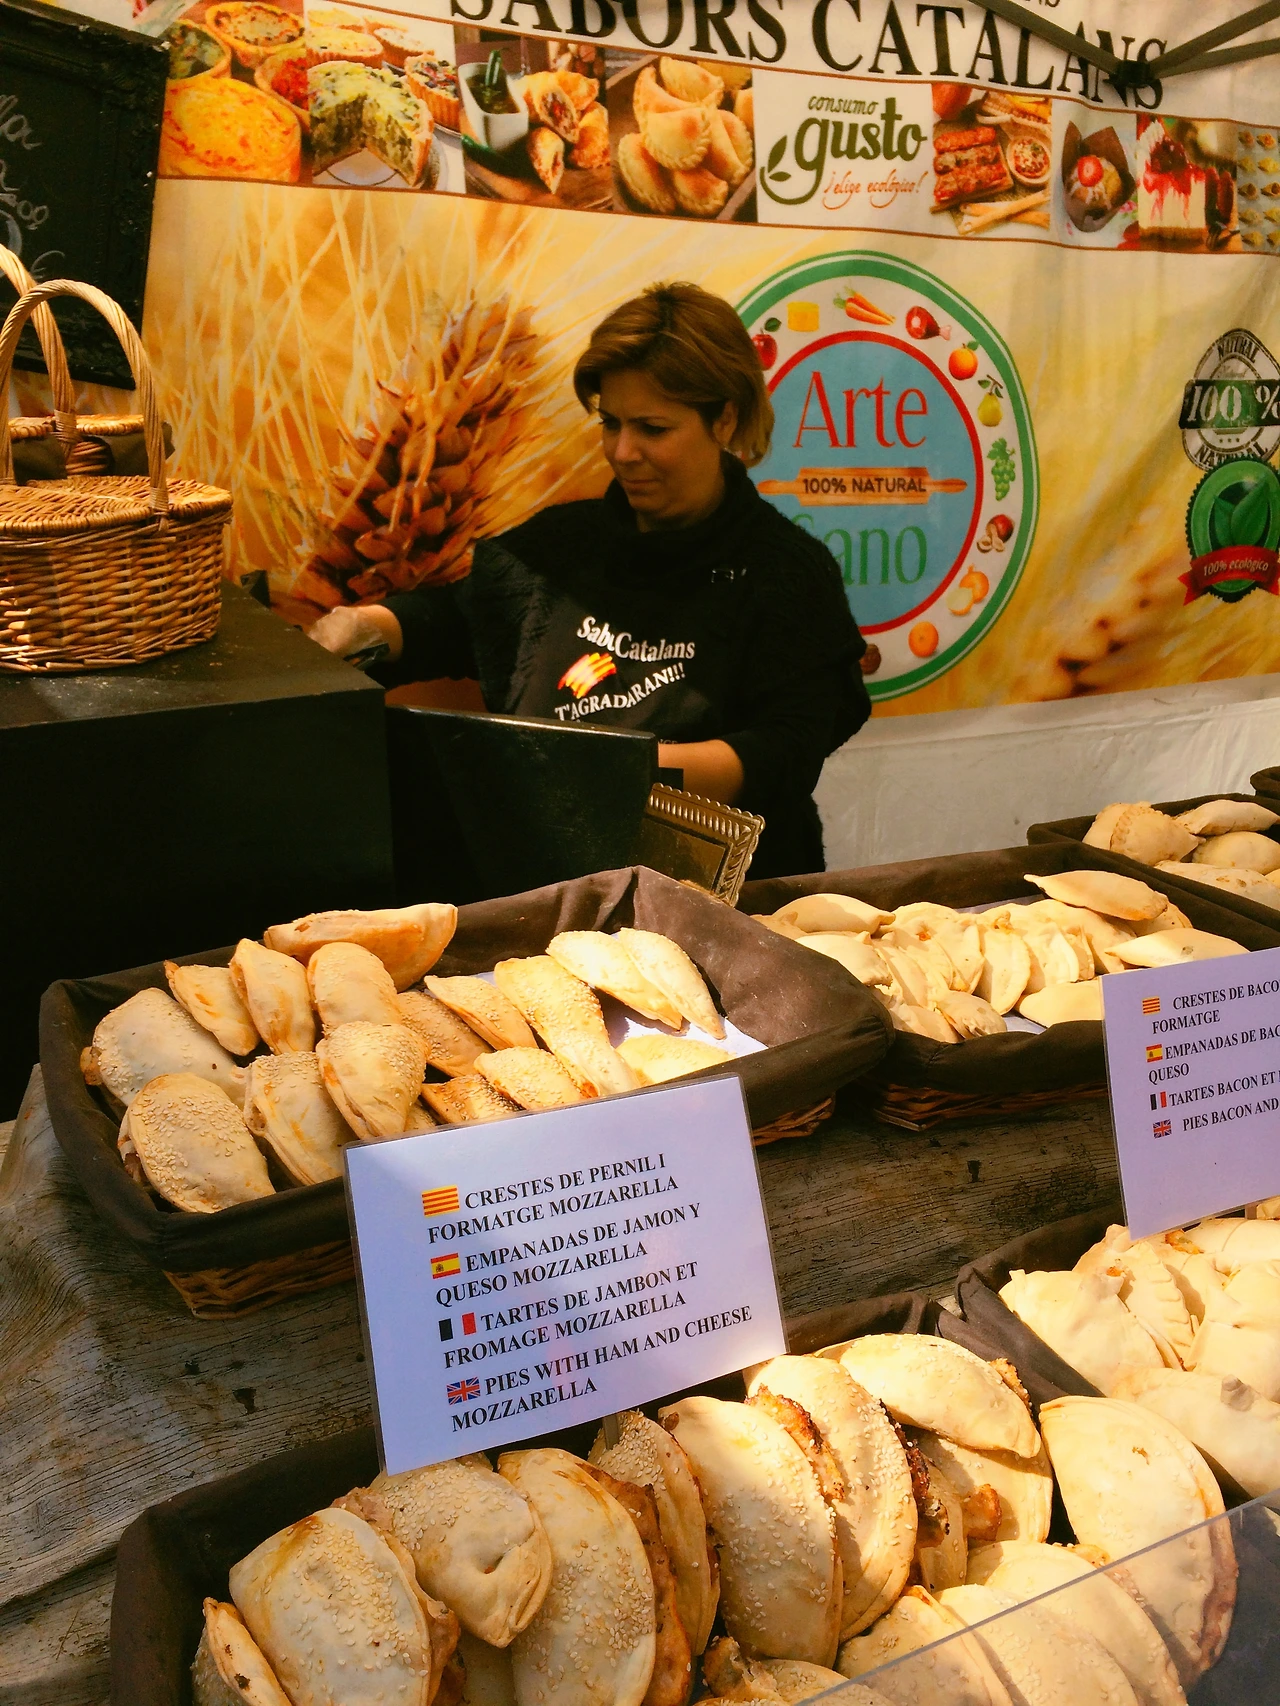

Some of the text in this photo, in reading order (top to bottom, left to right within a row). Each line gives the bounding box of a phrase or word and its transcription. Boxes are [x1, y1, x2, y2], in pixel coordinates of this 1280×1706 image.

[451, 0, 787, 63] BORS
[808, 95, 879, 116] consumo
[760, 97, 928, 205] gusto
[792, 371, 928, 448] Arte
[803, 477, 927, 494] 100% NATURAL
[791, 513, 928, 586] ano
[1203, 560, 1228, 577] 100%
[615, 631, 696, 663] Catalans
[554, 662, 686, 721] T'AGRADARAN!!!
[1152, 1009, 1221, 1035] FORMATGE
[1173, 979, 1280, 1010] CRESTES DE BACO
[1165, 1033, 1238, 1060] EMPANADAS
[1241, 1029, 1257, 1044] DE
[1148, 1062, 1190, 1086] QUESO
[1169, 1084, 1215, 1107] TARTES
[1217, 1074, 1259, 1096] BACON
[1261, 1071, 1276, 1086] ET
[1183, 1097, 1279, 1132] PIES BACON AND
[465, 1153, 666, 1209] CRESTES DE PERNIL I
[428, 1175, 679, 1244] FORMATGE MOZZARELLA
[465, 1202, 700, 1273] EMPANADAS DE JAMON Y
[436, 1241, 648, 1308] QUESO MOZZARELLA
[480, 1261, 698, 1332] TARTES DE JAMBON ET
[444, 1291, 687, 1369] FROMAGE MOZZARELLA
[485, 1305, 752, 1396] PIES WITH HAM AND CHEESE
[451, 1377, 598, 1432] MOZZARELLA
